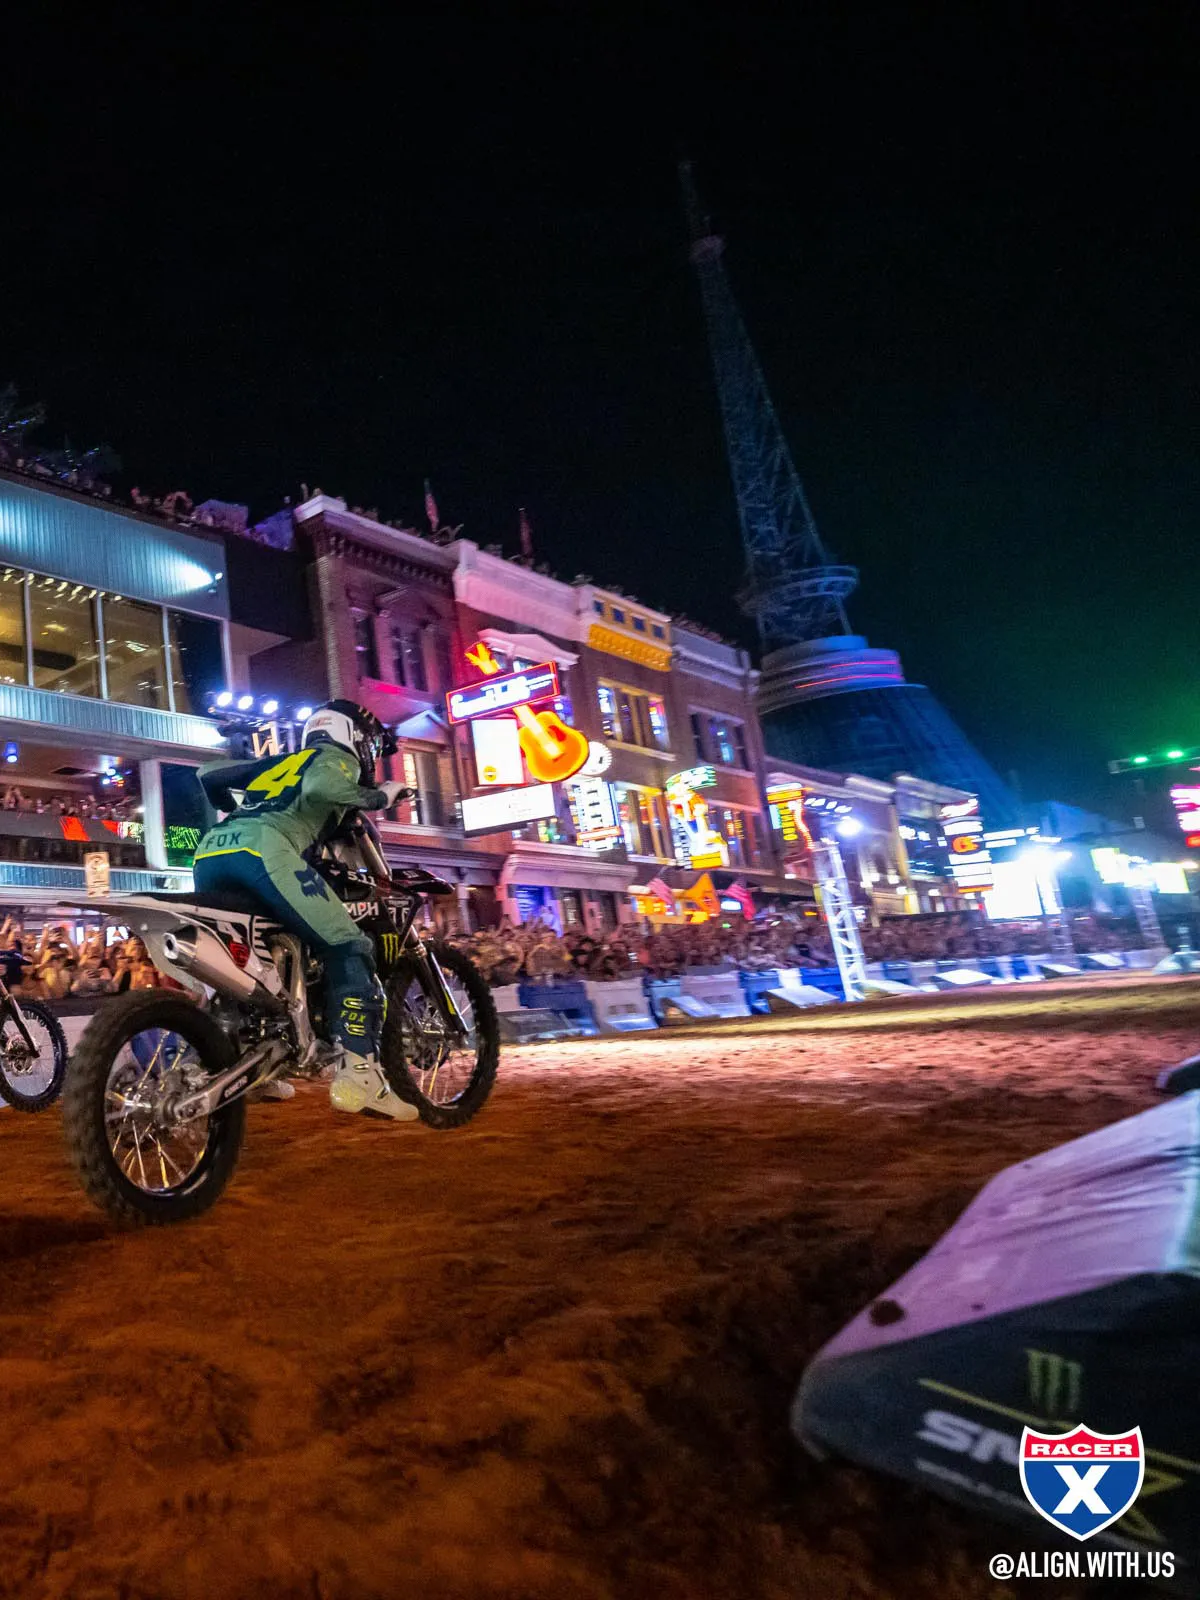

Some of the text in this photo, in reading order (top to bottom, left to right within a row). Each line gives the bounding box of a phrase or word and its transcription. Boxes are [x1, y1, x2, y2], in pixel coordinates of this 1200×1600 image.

[246, 748, 317, 800] 4
[205, 832, 242, 850] FOX
[339, 1009, 367, 1023] FOX
